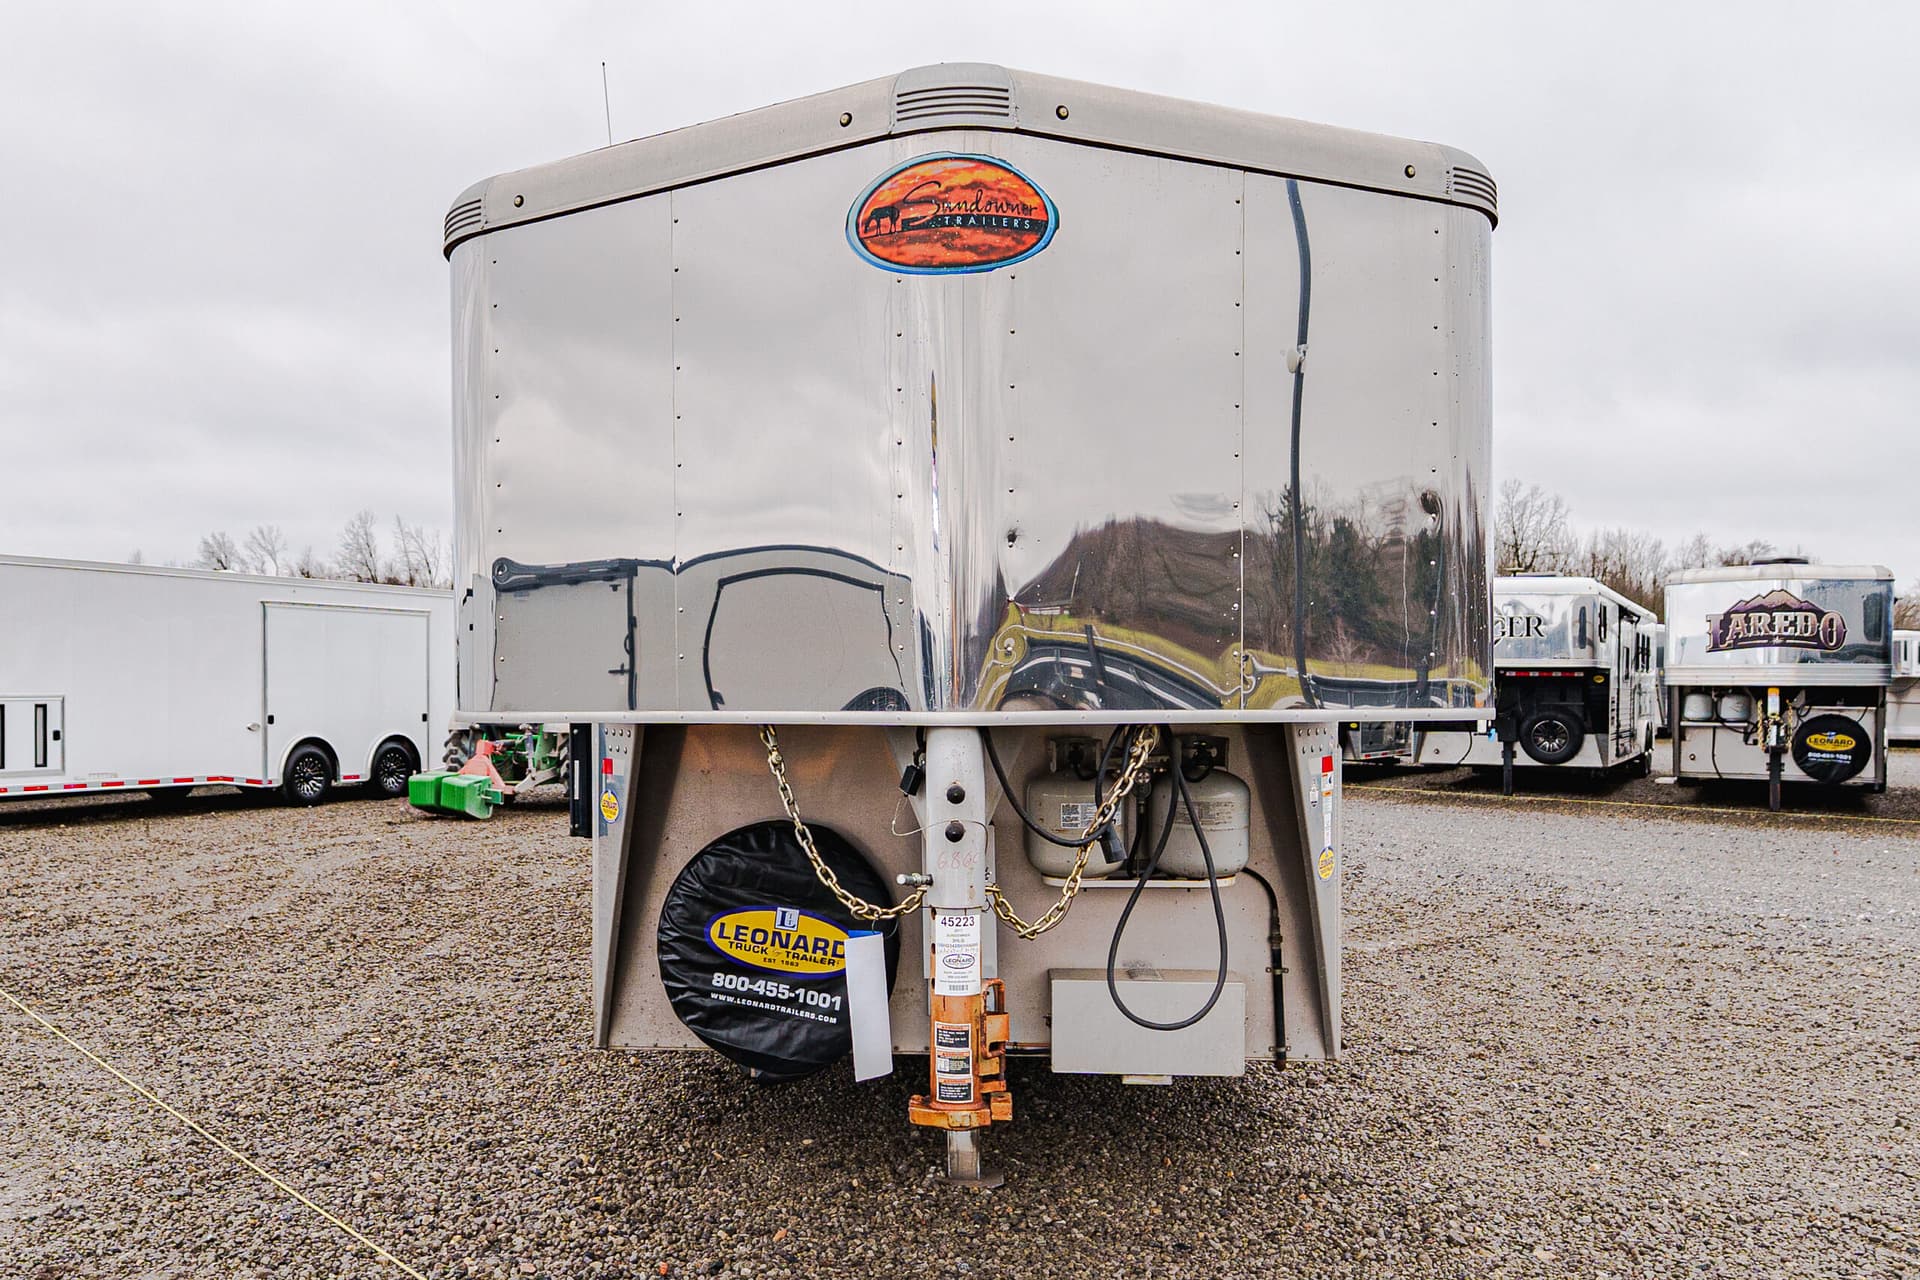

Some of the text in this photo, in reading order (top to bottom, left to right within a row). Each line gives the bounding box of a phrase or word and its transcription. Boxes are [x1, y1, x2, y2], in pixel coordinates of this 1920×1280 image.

[944, 216, 1030, 229] TRAILERS
[1706, 610, 1848, 653] LAREDO
[941, 916, 975, 927] 45223
[728, 941, 768, 955] TRUCK
[786, 951, 836, 967] TRAILER
[712, 972, 842, 1011] 800-455-1001
[710, 992, 837, 1024] WWW.LEONARDTRAILERS.COM
